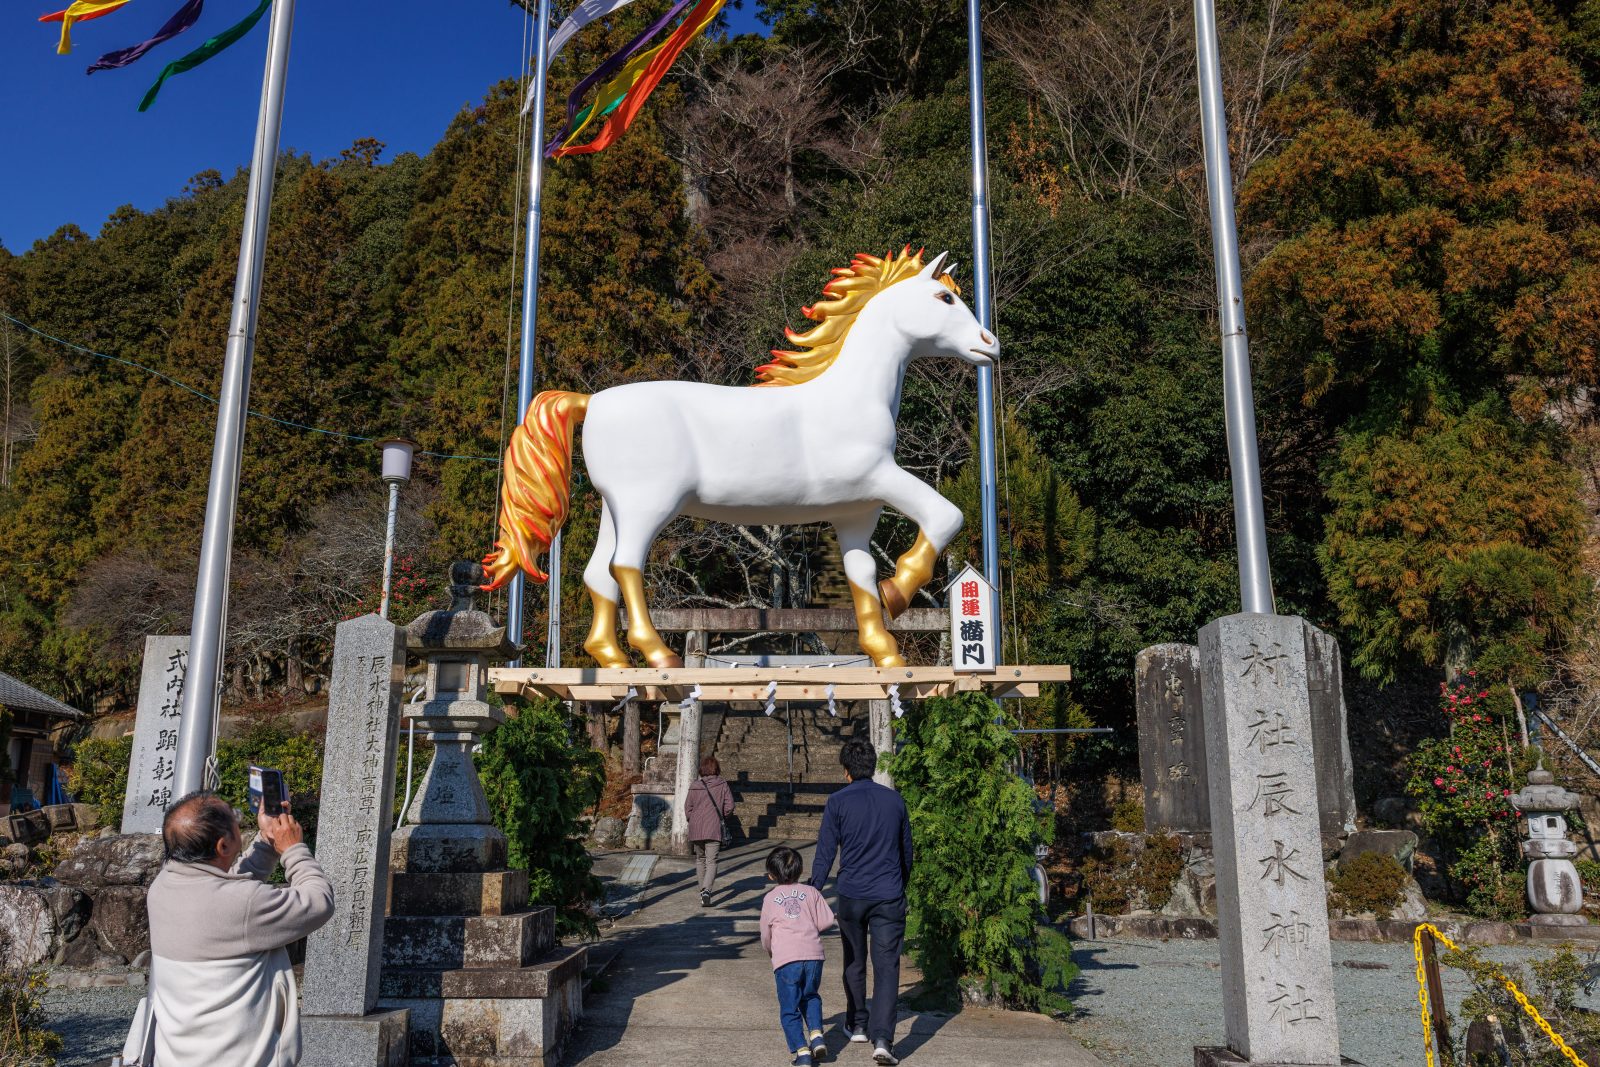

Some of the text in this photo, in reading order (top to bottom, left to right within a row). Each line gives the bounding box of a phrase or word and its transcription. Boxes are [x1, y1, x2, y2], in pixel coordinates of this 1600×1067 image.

[1240, 642, 1322, 1034] 村社辰水神社
